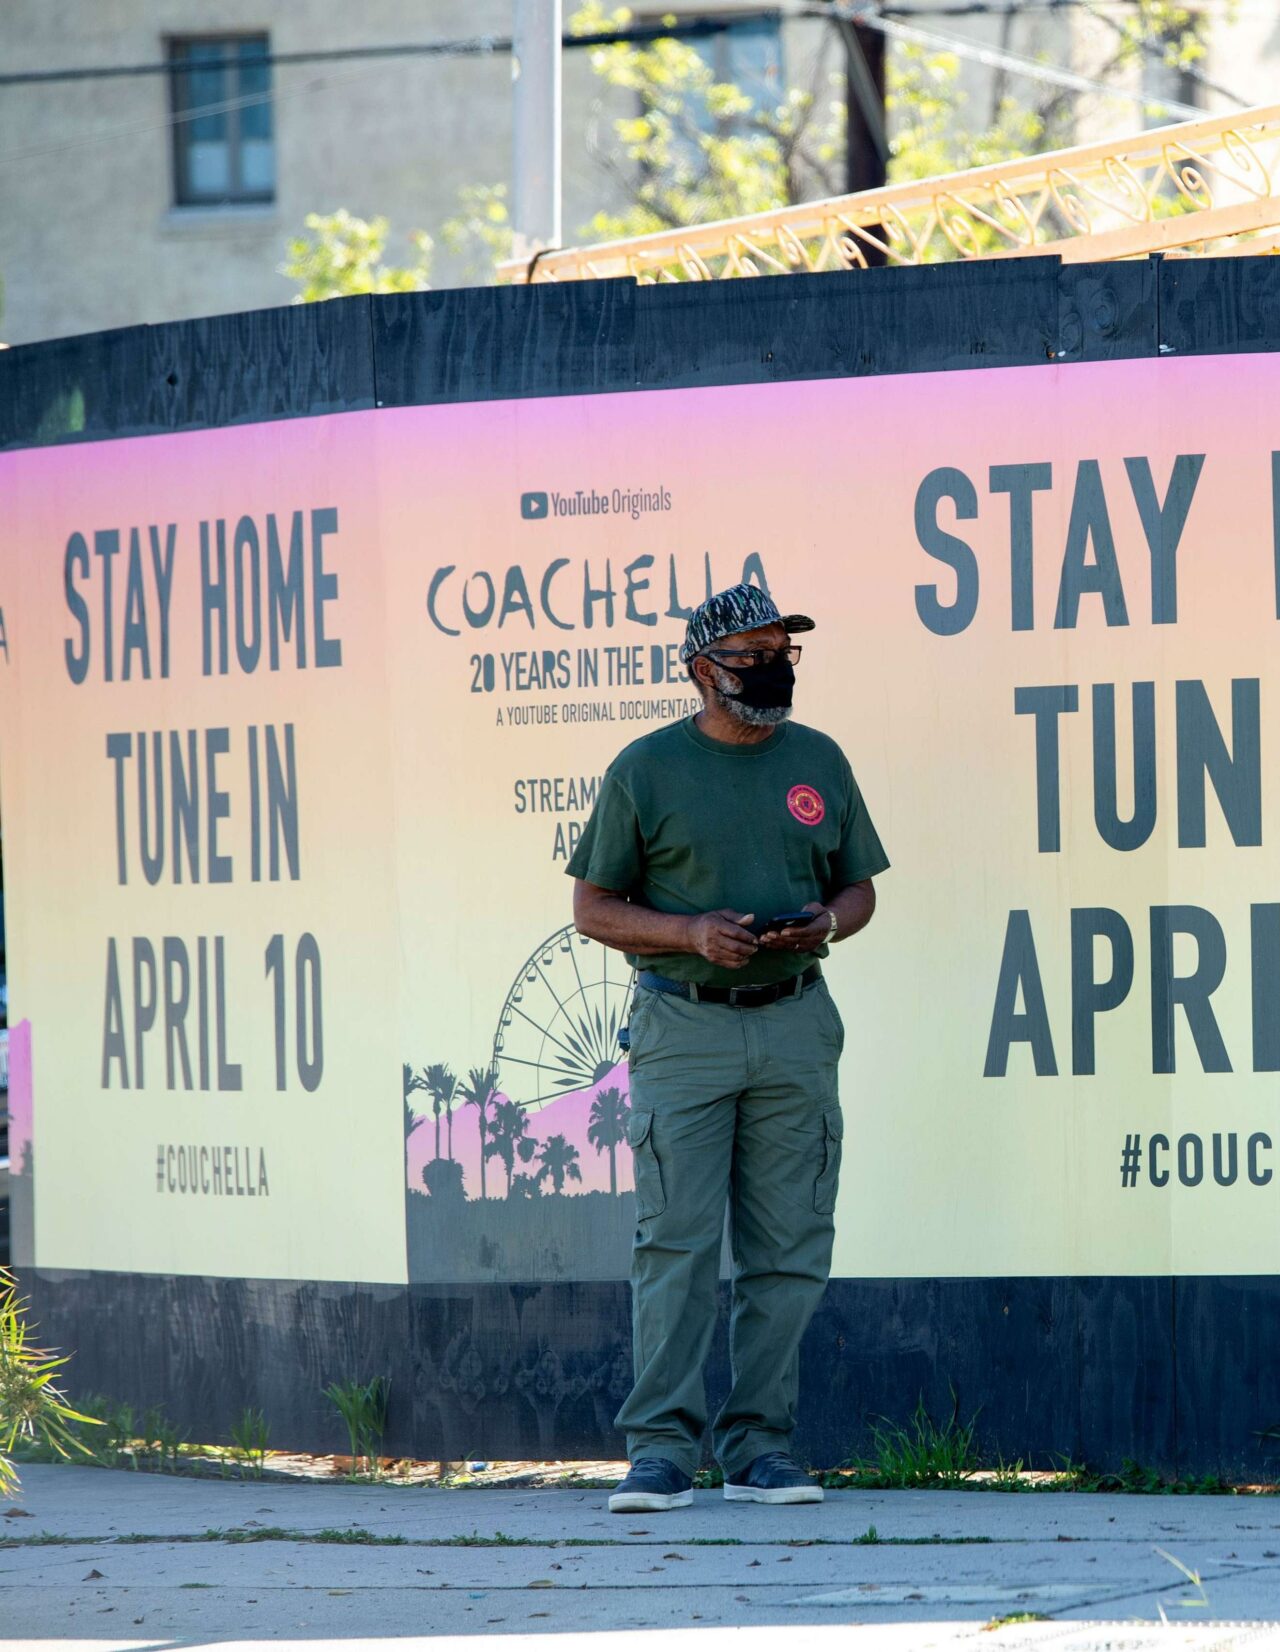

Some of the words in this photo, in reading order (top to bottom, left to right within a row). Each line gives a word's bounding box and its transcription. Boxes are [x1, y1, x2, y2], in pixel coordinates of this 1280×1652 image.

[551, 489, 609, 517] YouTube
[612, 485, 671, 520] Originals
[914, 453, 1206, 636] STAY
[63, 523, 177, 685] STAY
[199, 507, 343, 676] HOME
[470, 653, 495, 693] 20
[500, 649, 571, 691] YEARS
[577, 648, 598, 688] IN
[603, 645, 644, 686] THE
[496, 708, 503, 726] A
[507, 704, 558, 725] YOUTUBE
[562, 702, 615, 723] ORIGINAL
[106, 727, 233, 886] TUNE
[247, 723, 300, 882] IN
[102, 936, 243, 1091] APRIL
[265, 932, 324, 1092] 10
[157, 1145, 269, 1196] #COUCHELLA
